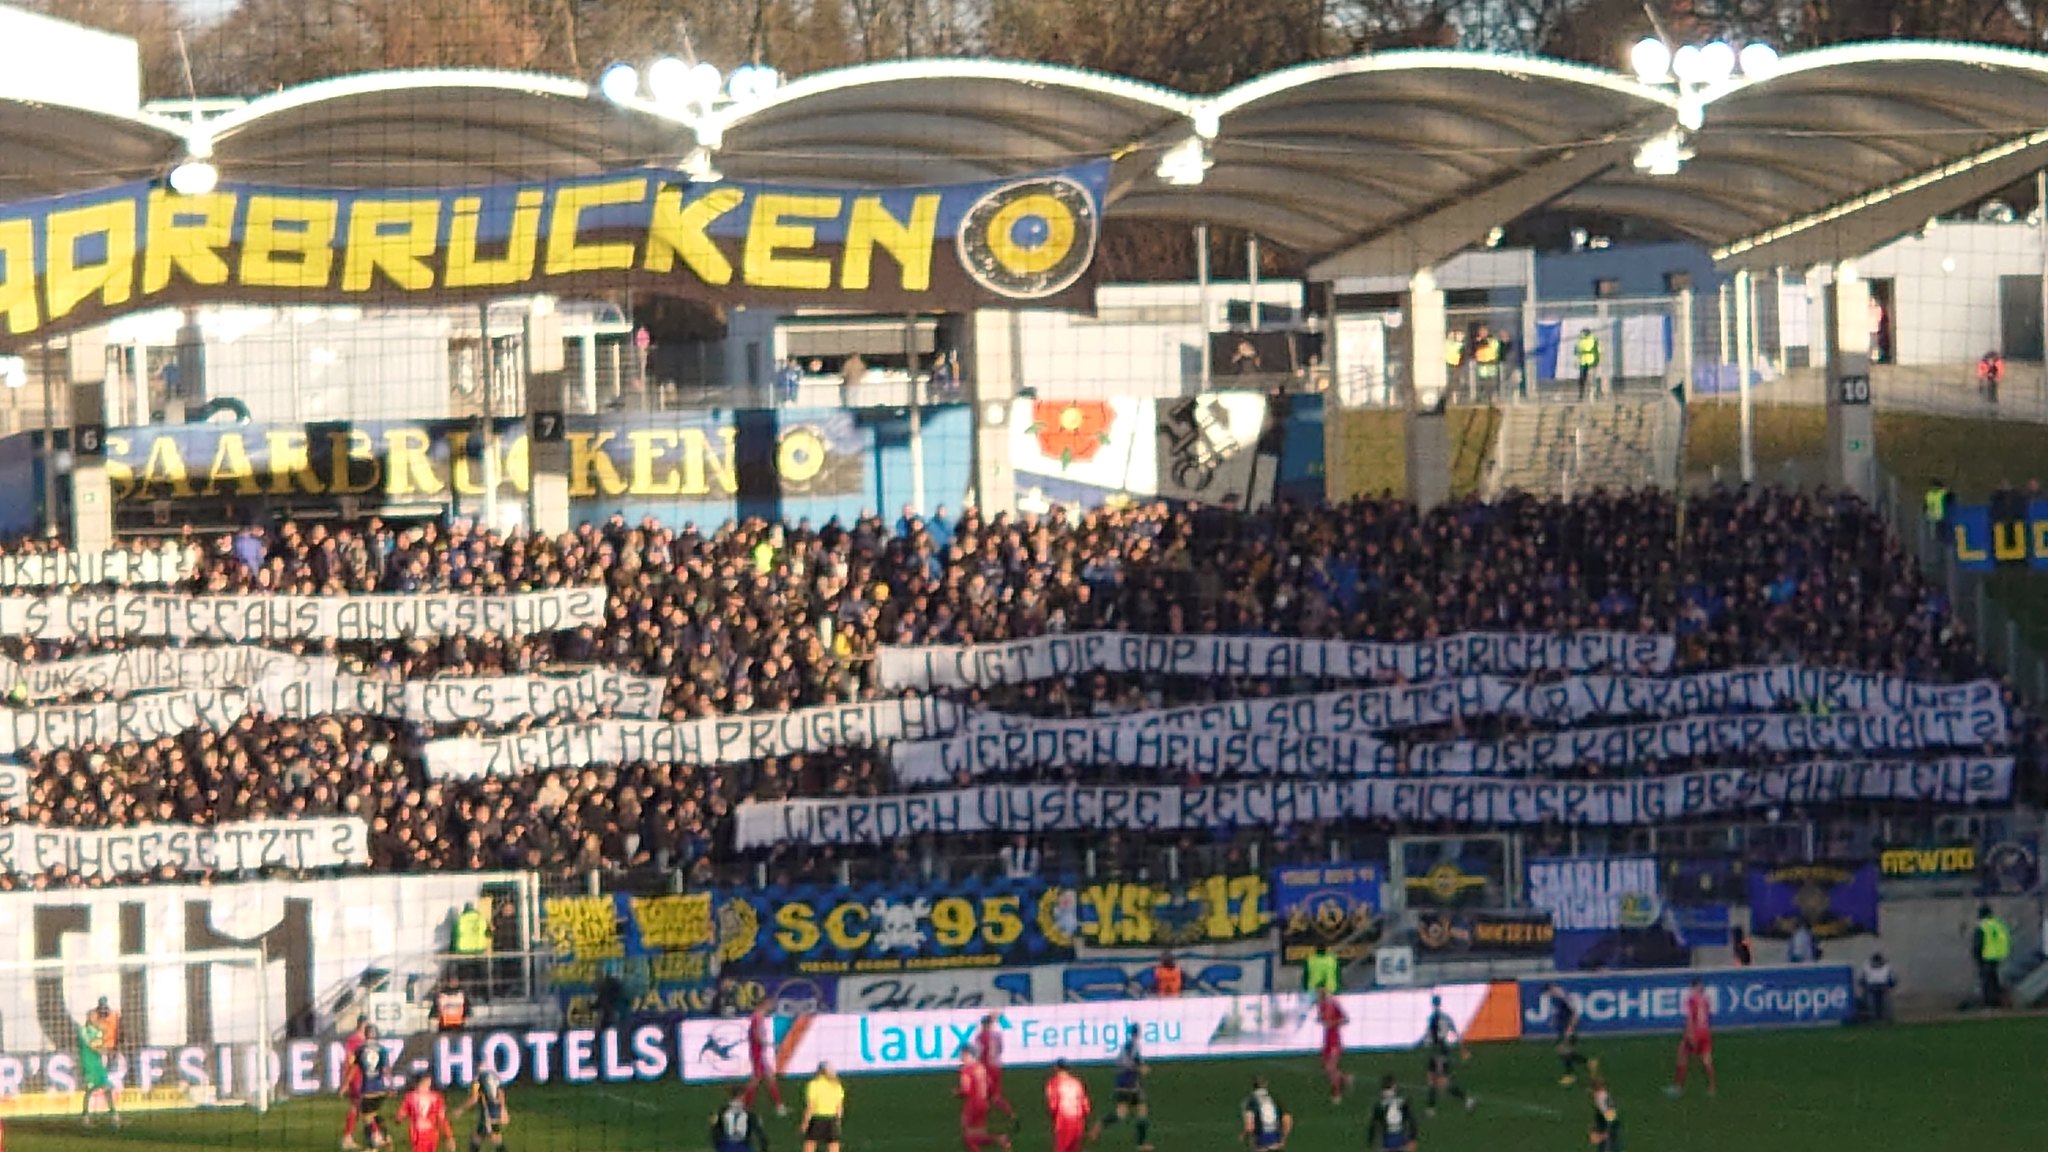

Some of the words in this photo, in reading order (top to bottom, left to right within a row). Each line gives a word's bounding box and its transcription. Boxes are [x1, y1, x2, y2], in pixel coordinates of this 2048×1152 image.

[1844, 379, 1869, 399] 10
[82, 431, 98, 451] 6
[541, 416, 554, 437] 7
[620, 724, 701, 764] MAN
[775, 901, 872, 952] SC
[930, 896, 1023, 945] 95
[1744, 983, 1847, 1018] Gruppe
[859, 1015, 977, 1063] laux
